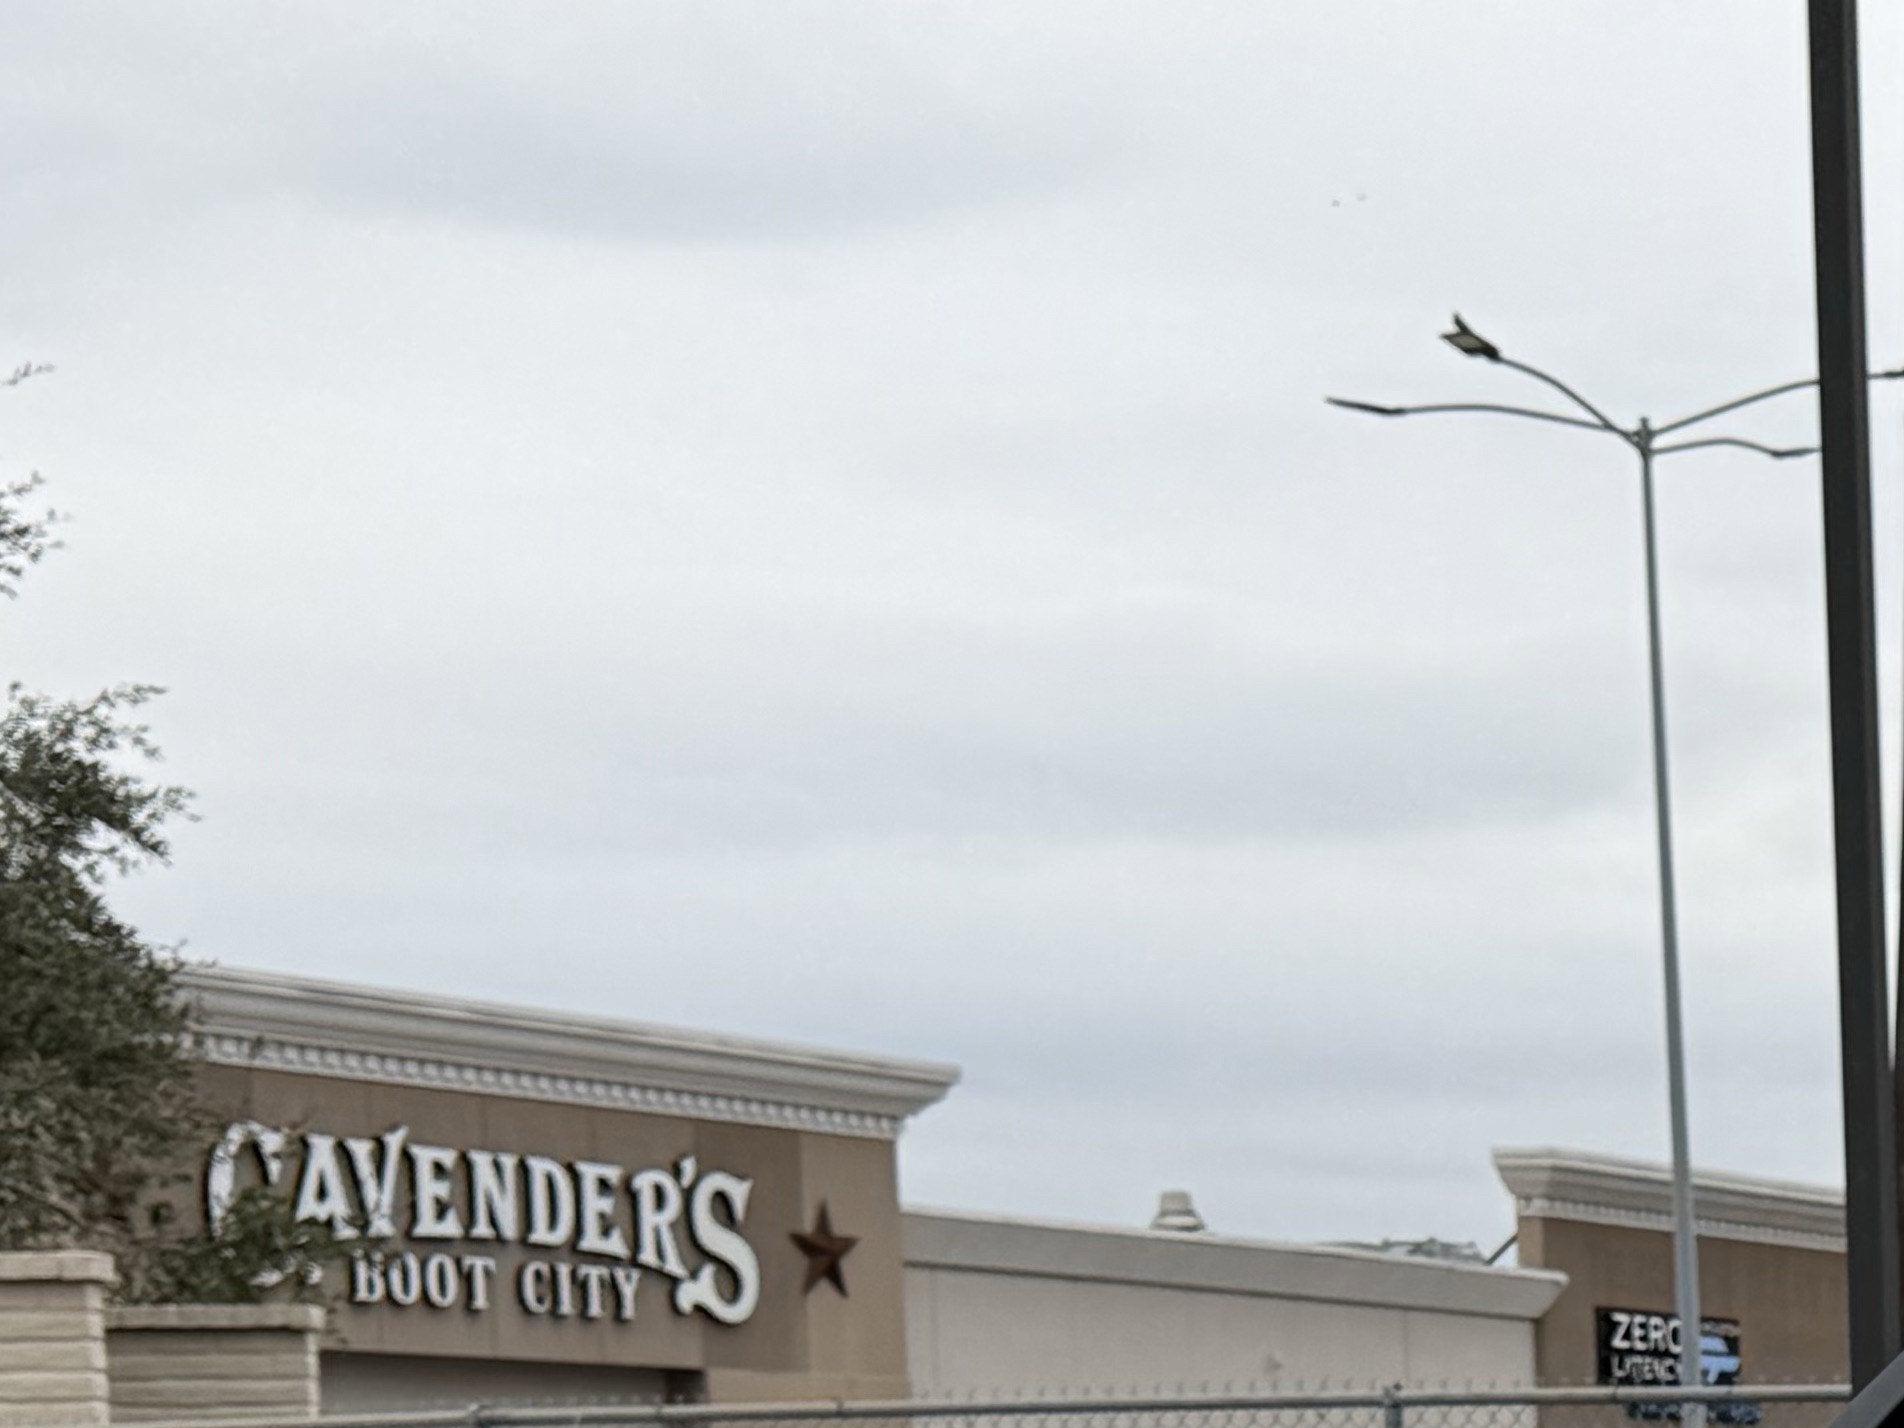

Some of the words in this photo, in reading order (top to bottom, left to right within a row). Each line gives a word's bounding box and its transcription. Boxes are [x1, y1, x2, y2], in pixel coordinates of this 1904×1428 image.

[208, 1120, 761, 1324] CAVENDER'S
[352, 1249, 496, 1309] BOOT
[520, 1261, 642, 1319] CITY
[1609, 1312, 1685, 1353] ZERO
